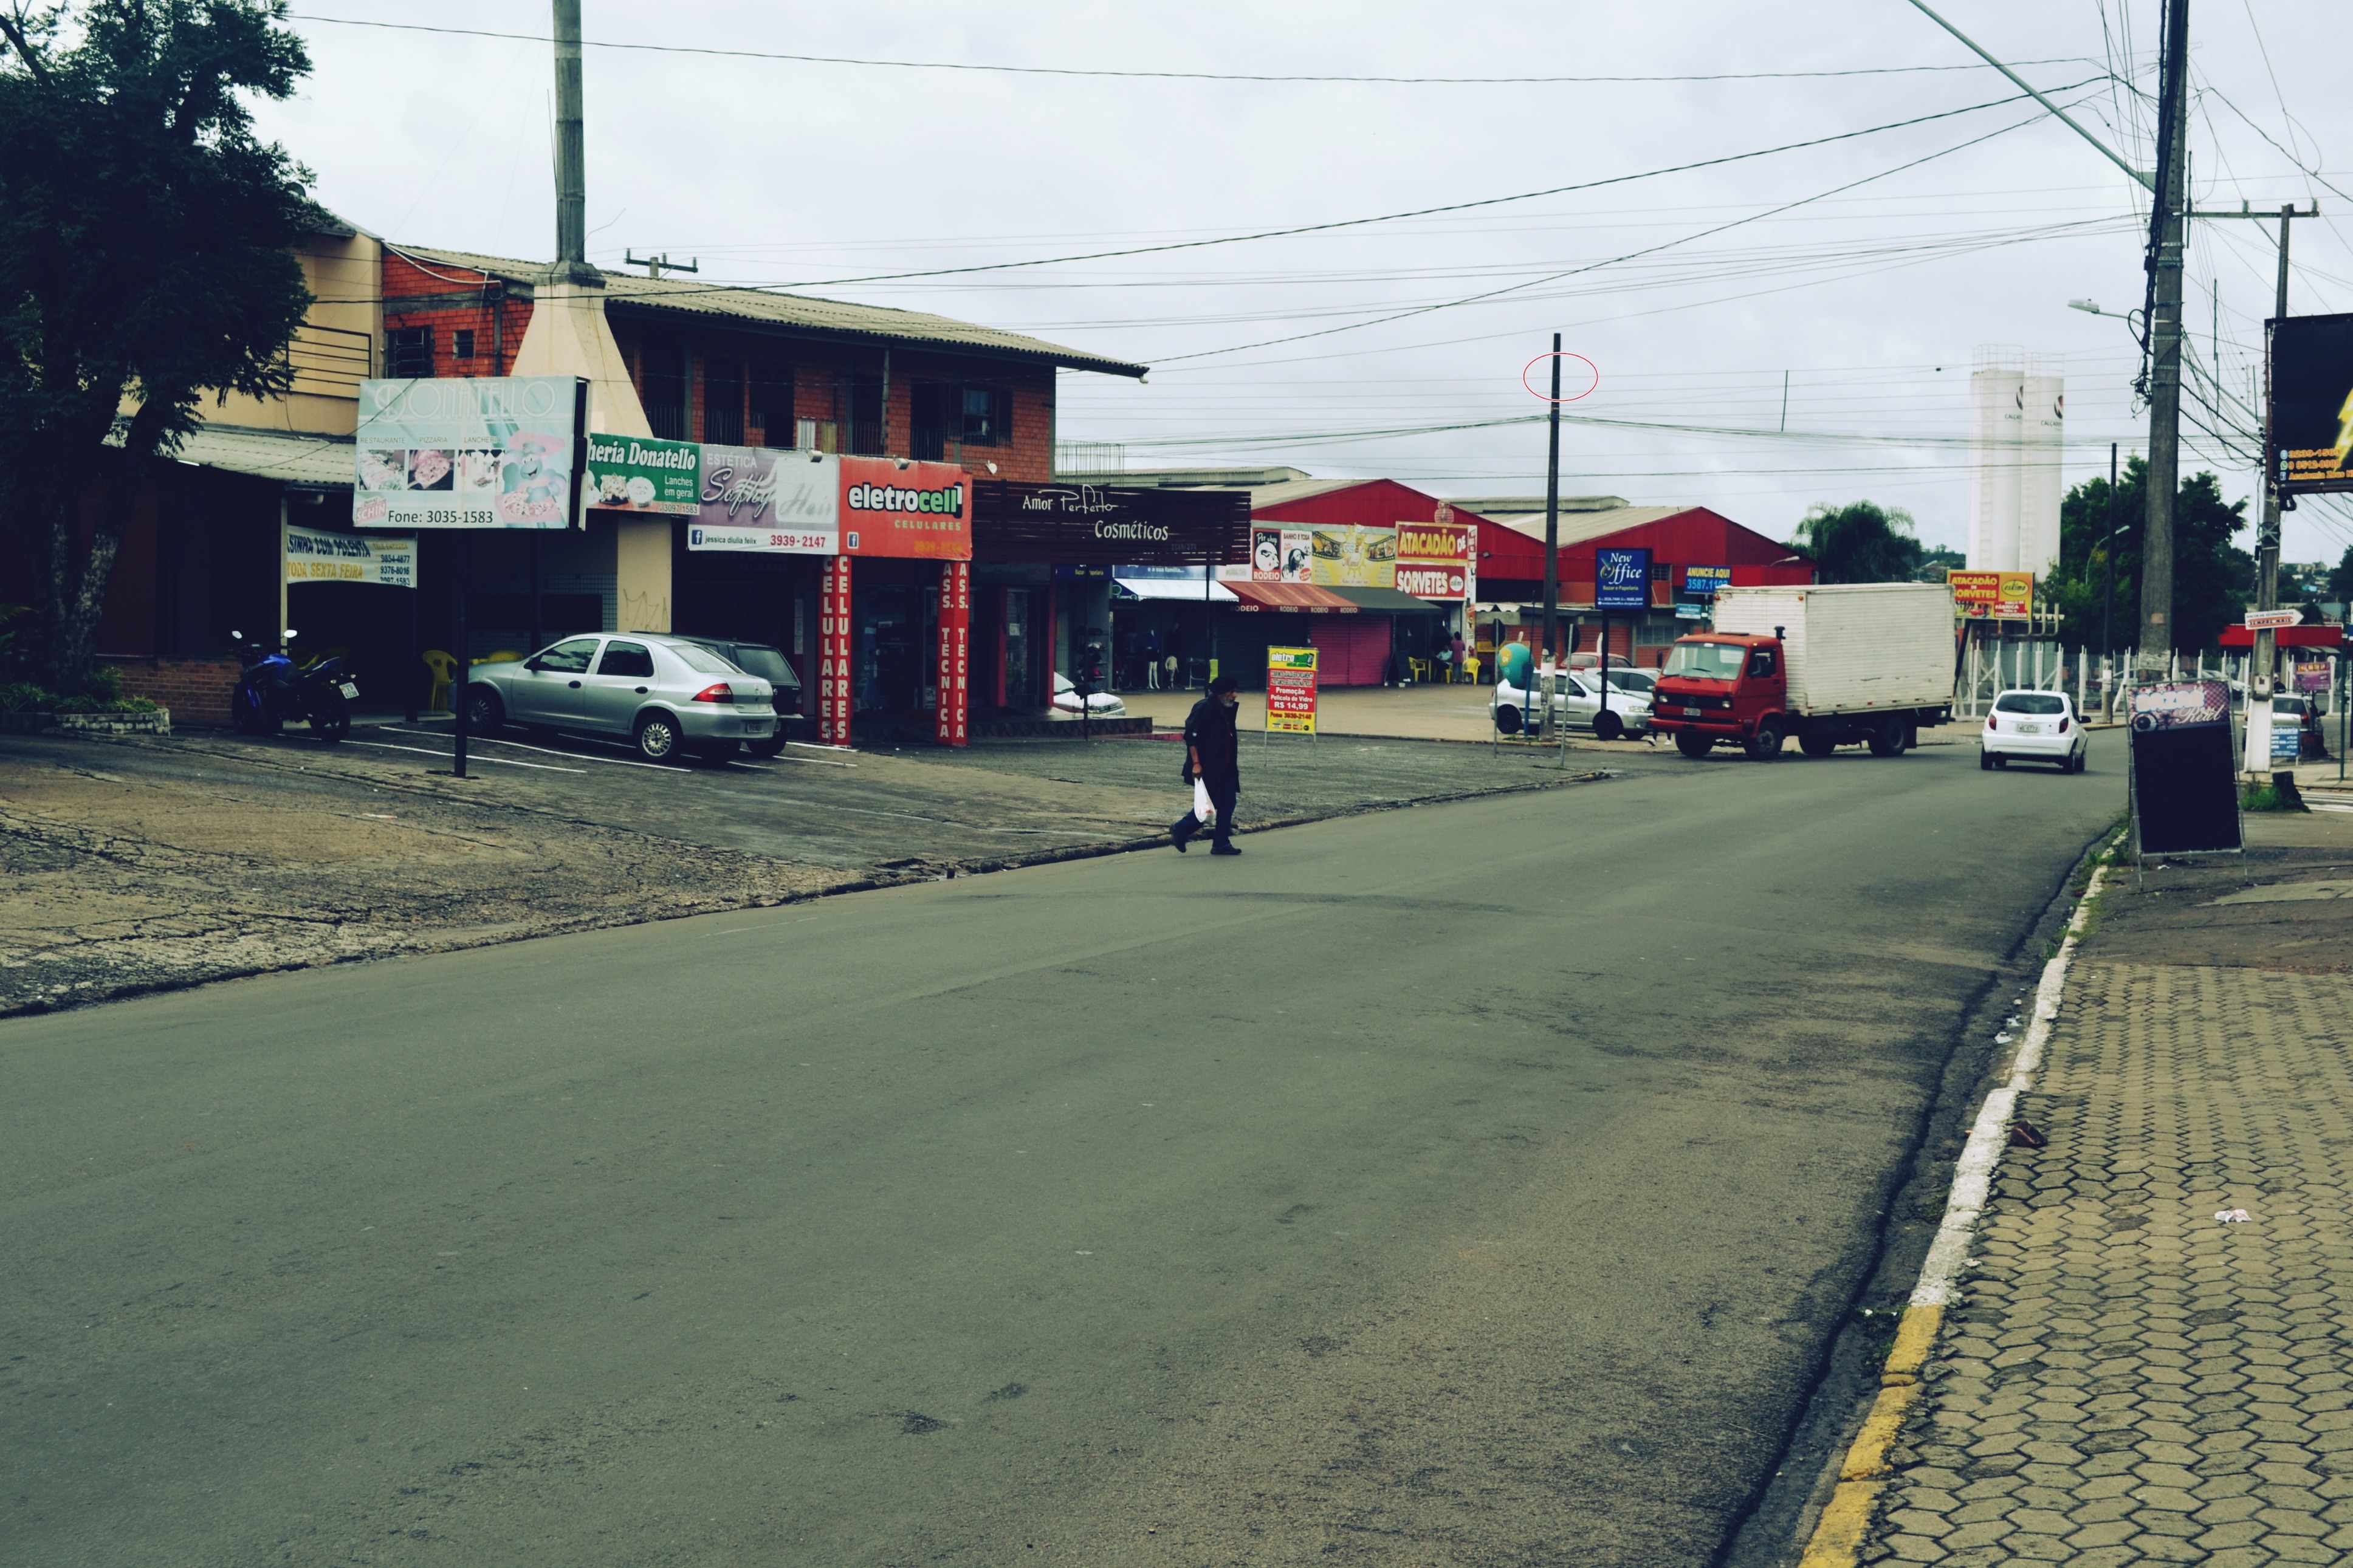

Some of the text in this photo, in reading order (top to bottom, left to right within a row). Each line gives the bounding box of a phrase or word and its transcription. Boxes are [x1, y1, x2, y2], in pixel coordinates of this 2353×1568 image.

[374, 380, 556, 423] DONATELLO
[627, 442, 696, 470] Donatello
[706, 451, 758, 468] ESTÉTICA
[664, 475, 693, 487] Lanches
[676, 488, 694, 499] geral
[778, 482, 833, 516] Hair
[848, 482, 961, 515] eletrocell
[1022, 484, 1113, 515] Amor Perfeito
[357, 503, 386, 521] SCHIN
[388, 510, 493, 524] Fone: 3035-1583
[894, 519, 961, 532] CELULARES
[1094, 520, 1169, 541] Cosméticos
[287, 535, 371, 558] SINHA COM POLENTA
[1398, 528, 1466, 556] ATACADÃO DE
[380, 554, 410, 564] 9854-4877
[1610, 552, 1632, 563] New
[287, 562, 363, 579] TODA SEXTA FEIRA
[380, 566, 410, 575] 9376-8016
[1254, 571, 1280, 580] RODEIO
[1687, 567, 1730, 578] ANUNCIE AQUI
[958, 563, 969, 609] ASS.
[1397, 570, 1448, 594] SORVETES
[1951, 575, 1997, 586] ATACADÃO
[1955, 589, 1997, 598] ORVETES
[837, 555, 849, 739] CELULARES
[1276, 686, 1305, 696] Promoção
